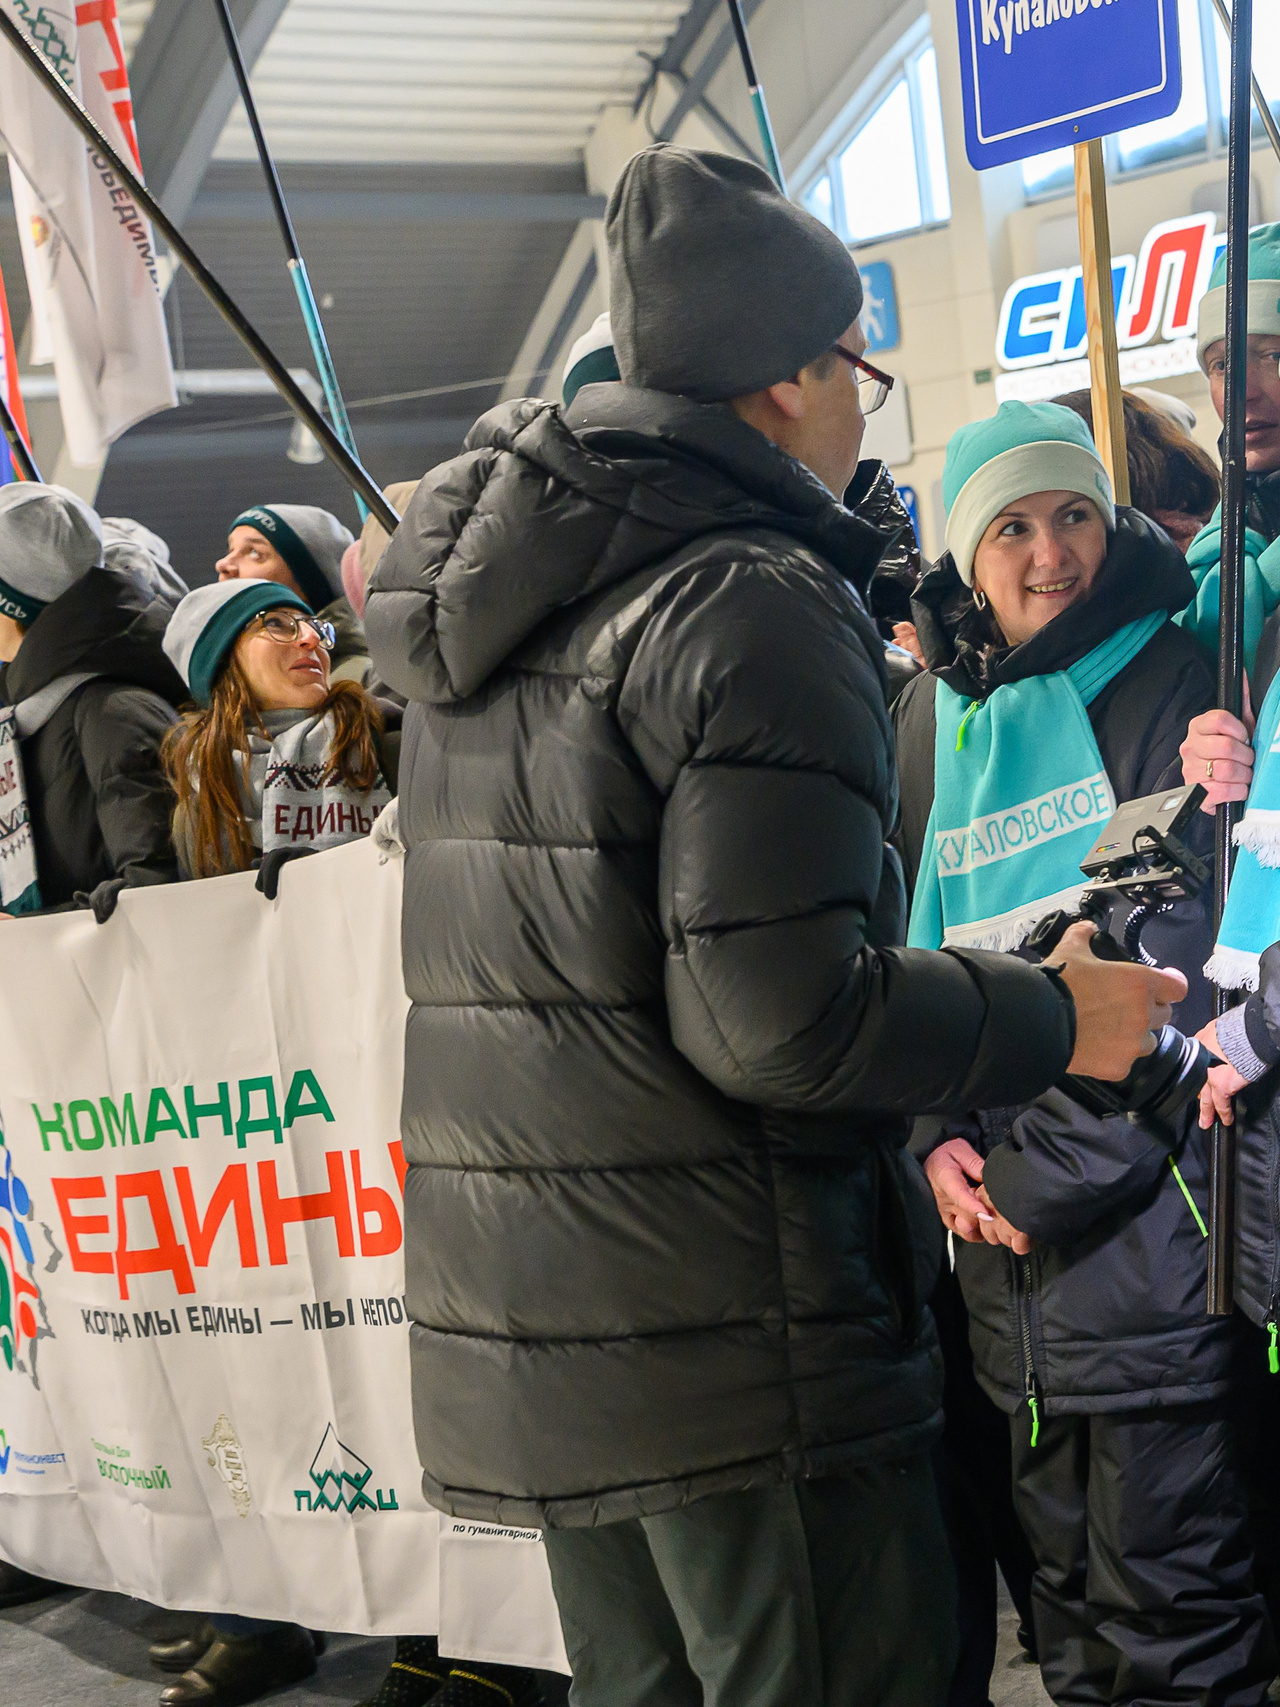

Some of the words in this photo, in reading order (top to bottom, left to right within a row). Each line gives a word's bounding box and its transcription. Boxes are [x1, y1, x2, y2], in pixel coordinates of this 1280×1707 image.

[30, 1068, 336, 1152] КОМАНДА
[51, 1140, 409, 1301] ЕДИНЫ
[80, 1308, 132, 1343] КОГДА
[132, 1308, 181, 1339] МЫ
[185, 1305, 263, 1338] ЕДИНЫ
[300, 1298, 356, 1331] МЫ
[453, 1524, 466, 1533] по
[468, 1525, 538, 1540] гуманитарной
